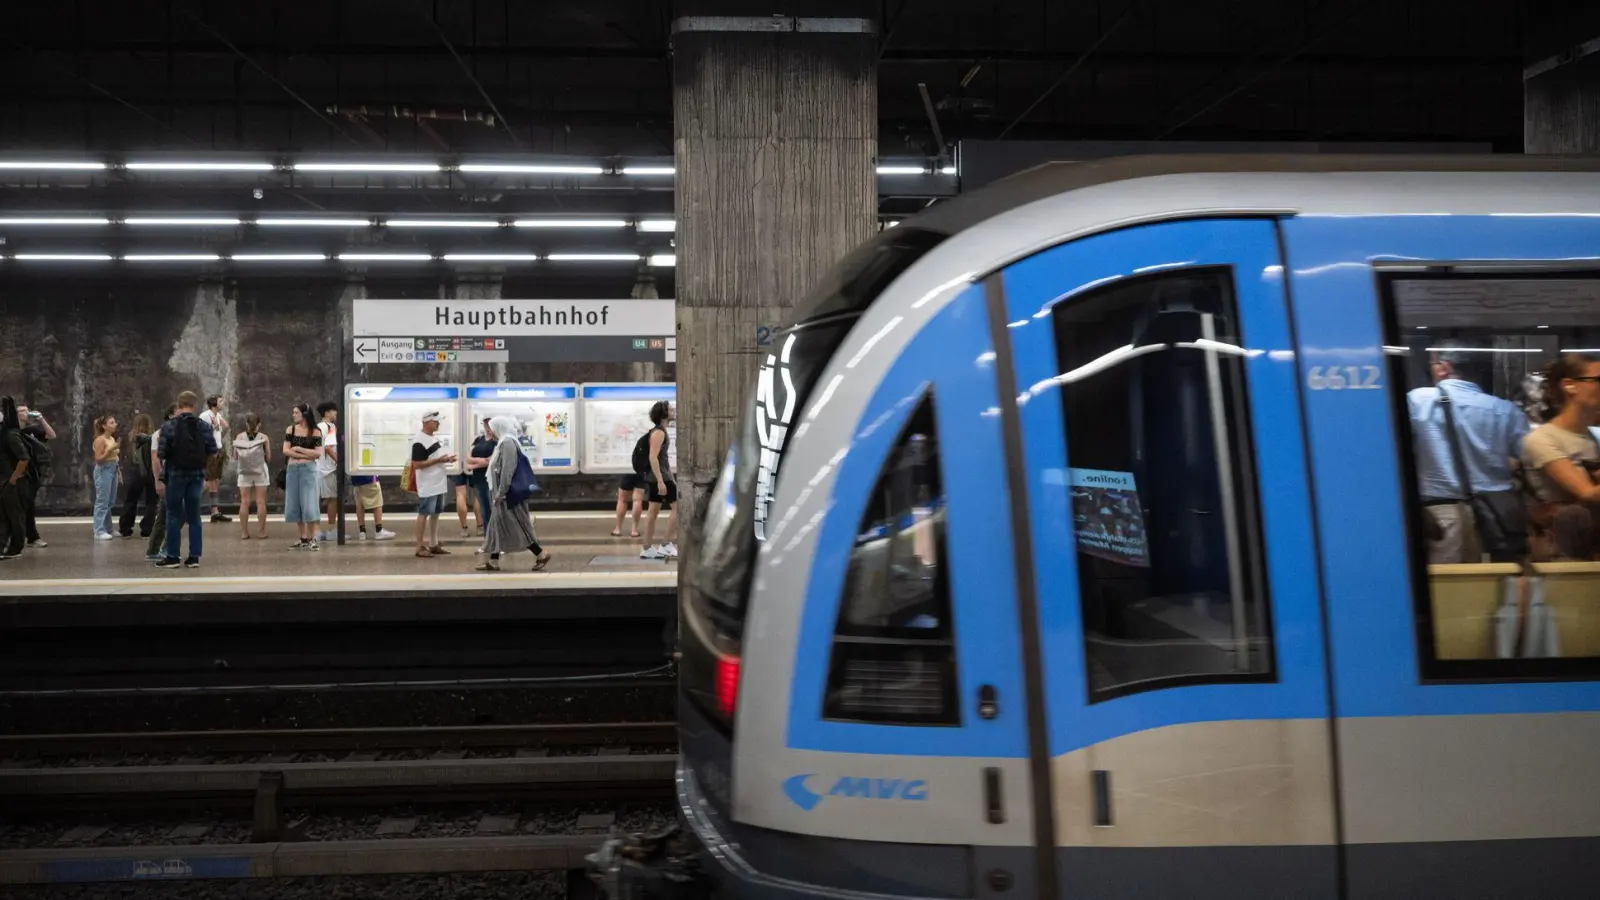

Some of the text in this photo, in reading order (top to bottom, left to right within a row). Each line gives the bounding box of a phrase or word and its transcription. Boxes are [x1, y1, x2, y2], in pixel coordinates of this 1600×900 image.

[435, 305, 609, 330] Hauptbahnhof
[380, 340, 413, 350] Ausgang
[635, 340, 646, 348] U4
[651, 340, 662, 348] U5
[381, 352, 394, 360] Exit
[1307, 365, 1383, 390] 6612
[829, 776, 926, 801] MVG
